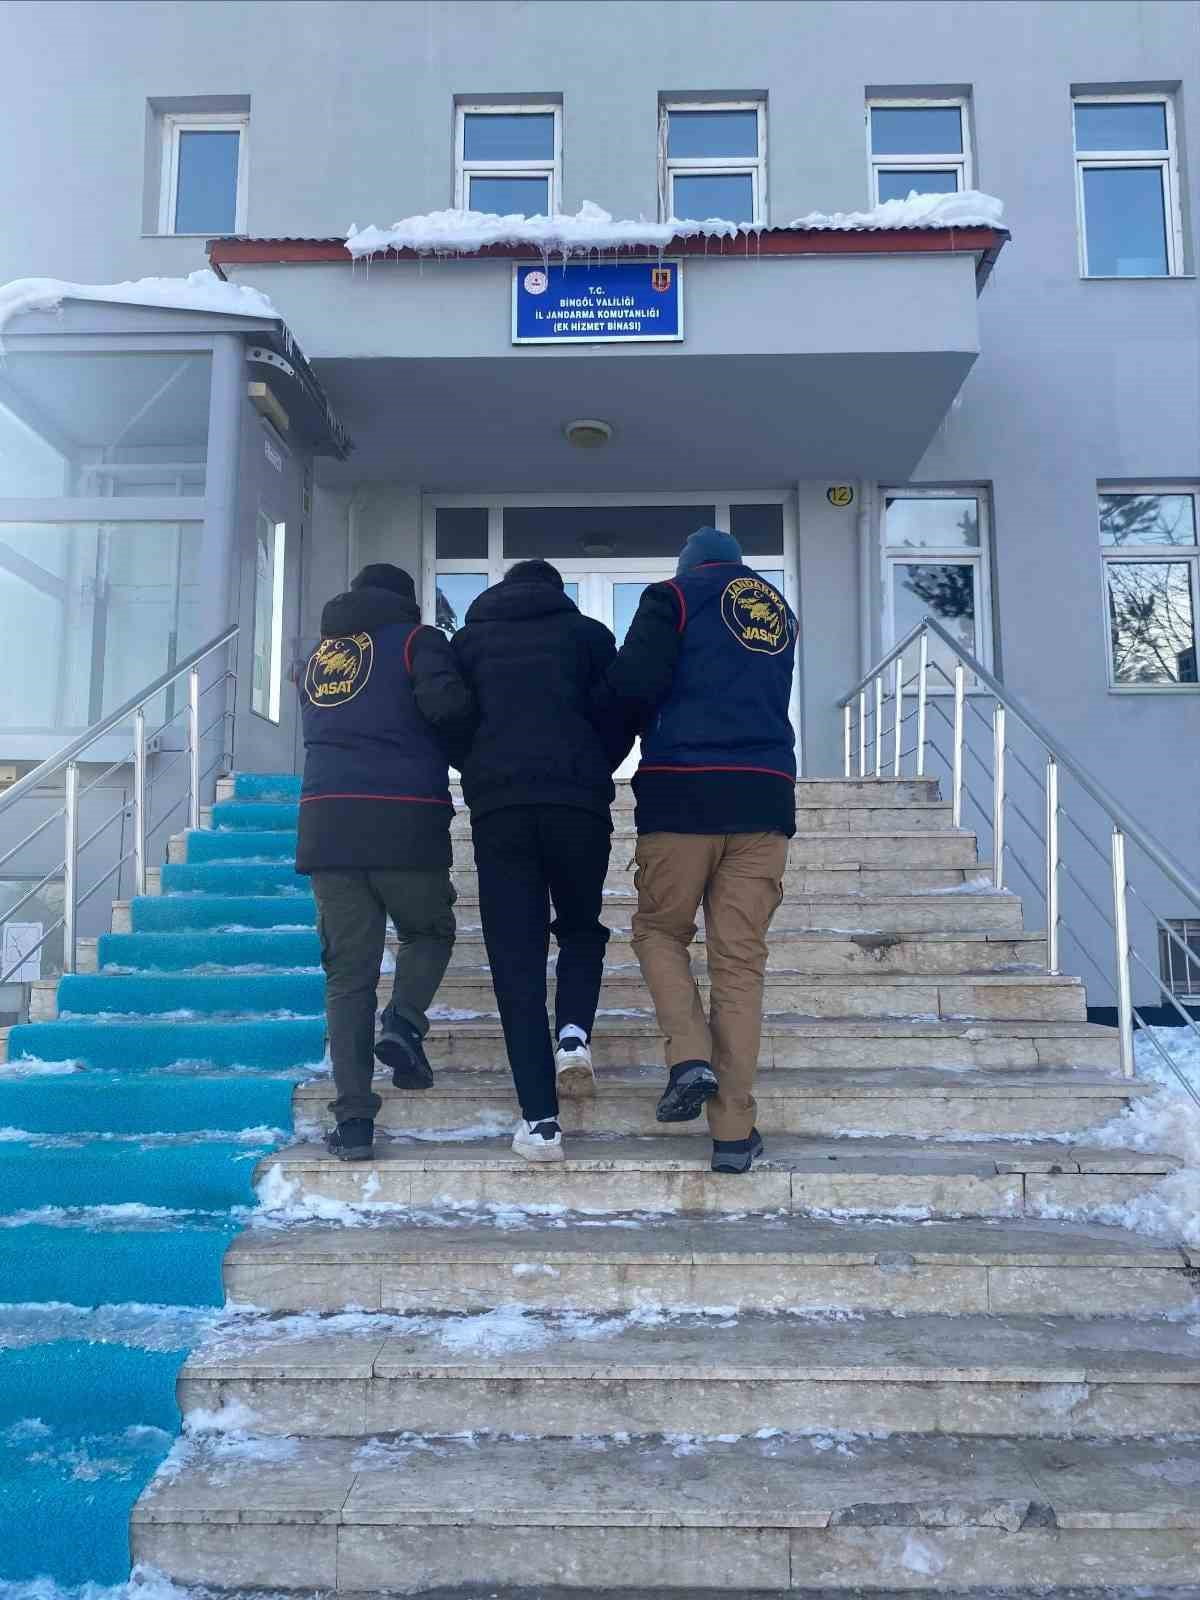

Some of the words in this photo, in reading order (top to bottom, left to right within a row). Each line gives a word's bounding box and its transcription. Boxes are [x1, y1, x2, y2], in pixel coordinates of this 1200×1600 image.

[589, 286, 605, 295] T.C.
[560, 297, 593, 307] BİNGÖL
[596, 296, 634, 306] VALİLİĞİ
[535, 310, 544, 320] İL
[546, 310, 594, 319] JANDARMA
[598, 307, 660, 318] KOMUTANLIĞI
[553, 322, 568, 333] (EK
[571, 321, 604, 331] HİZMET
[607, 320, 641, 331] BİNASI)
[832, 486, 848, 501] 12
[742, 626, 778, 647] JASAT
[314, 680, 354, 698] JASAT
